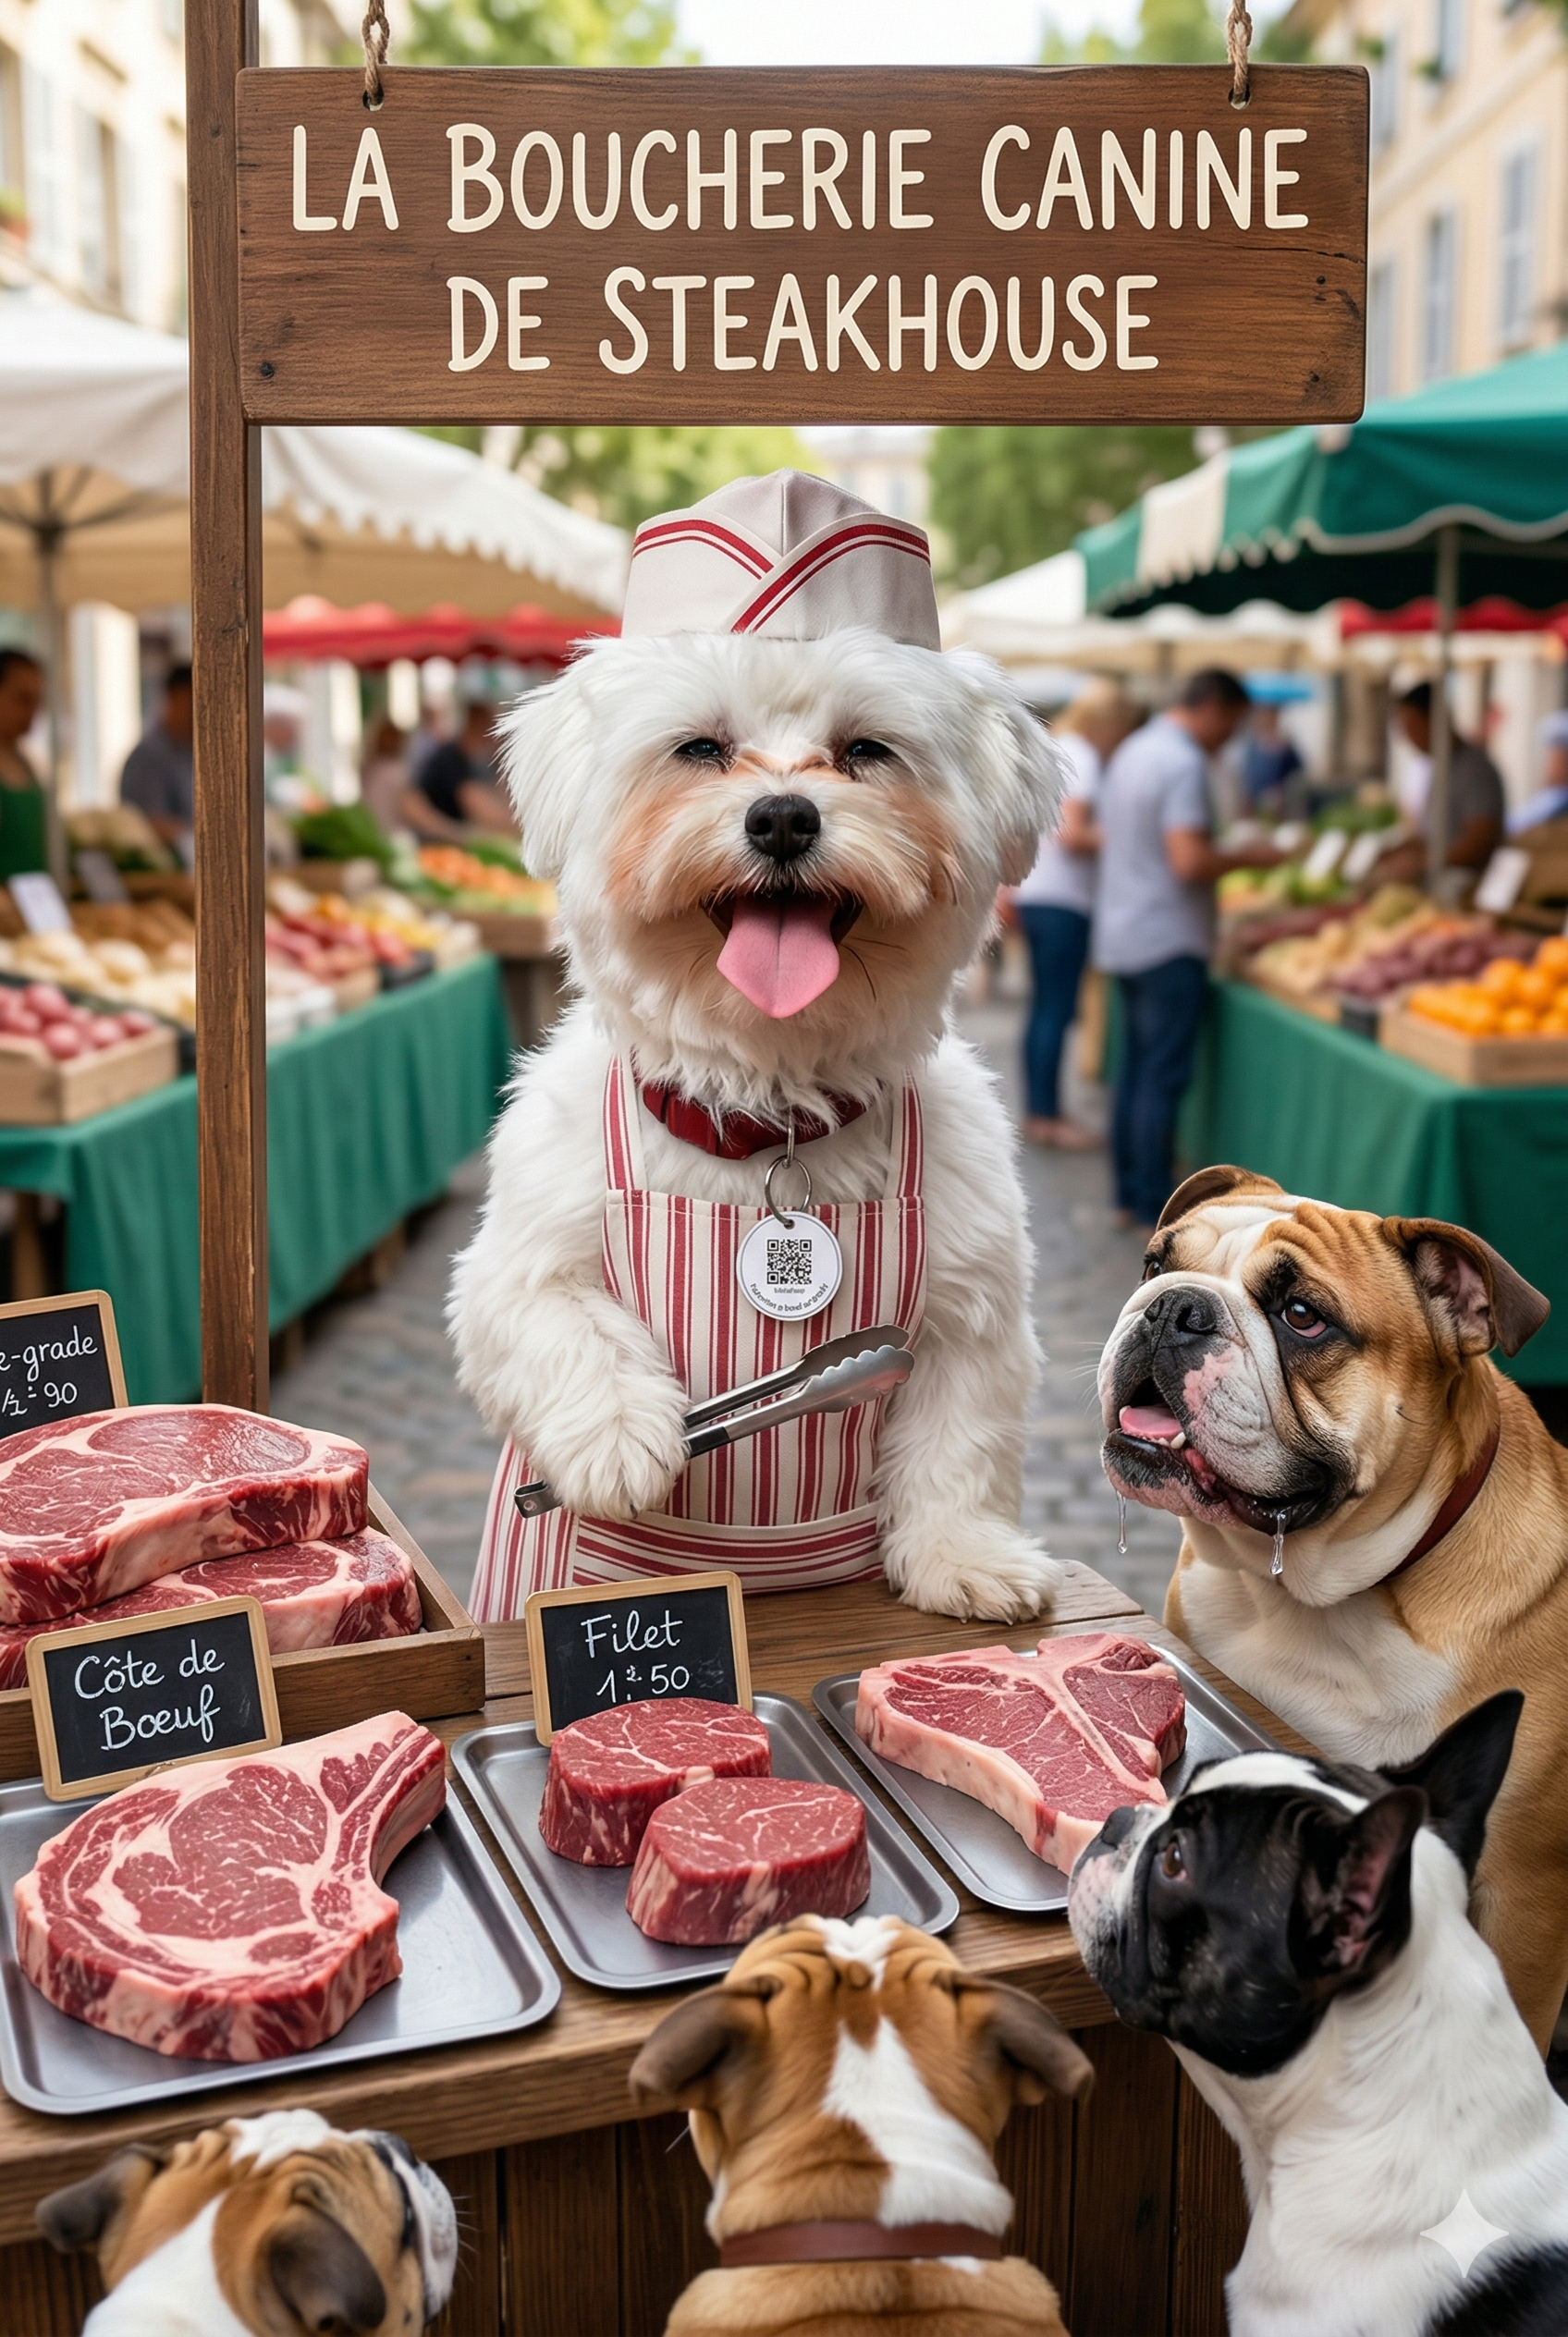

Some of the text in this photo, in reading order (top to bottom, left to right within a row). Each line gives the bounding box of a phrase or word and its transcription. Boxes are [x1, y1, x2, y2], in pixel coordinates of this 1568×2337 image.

[292, 124, 1309, 232] LA BOUCHERIE CANINE
[447, 266, 1159, 374] DE STEAKHOUSE
[580, 1609, 683, 1658] Filet
[74, 1638, 226, 1699] Côte de
[99, 1683, 221, 1751] Bœuf
